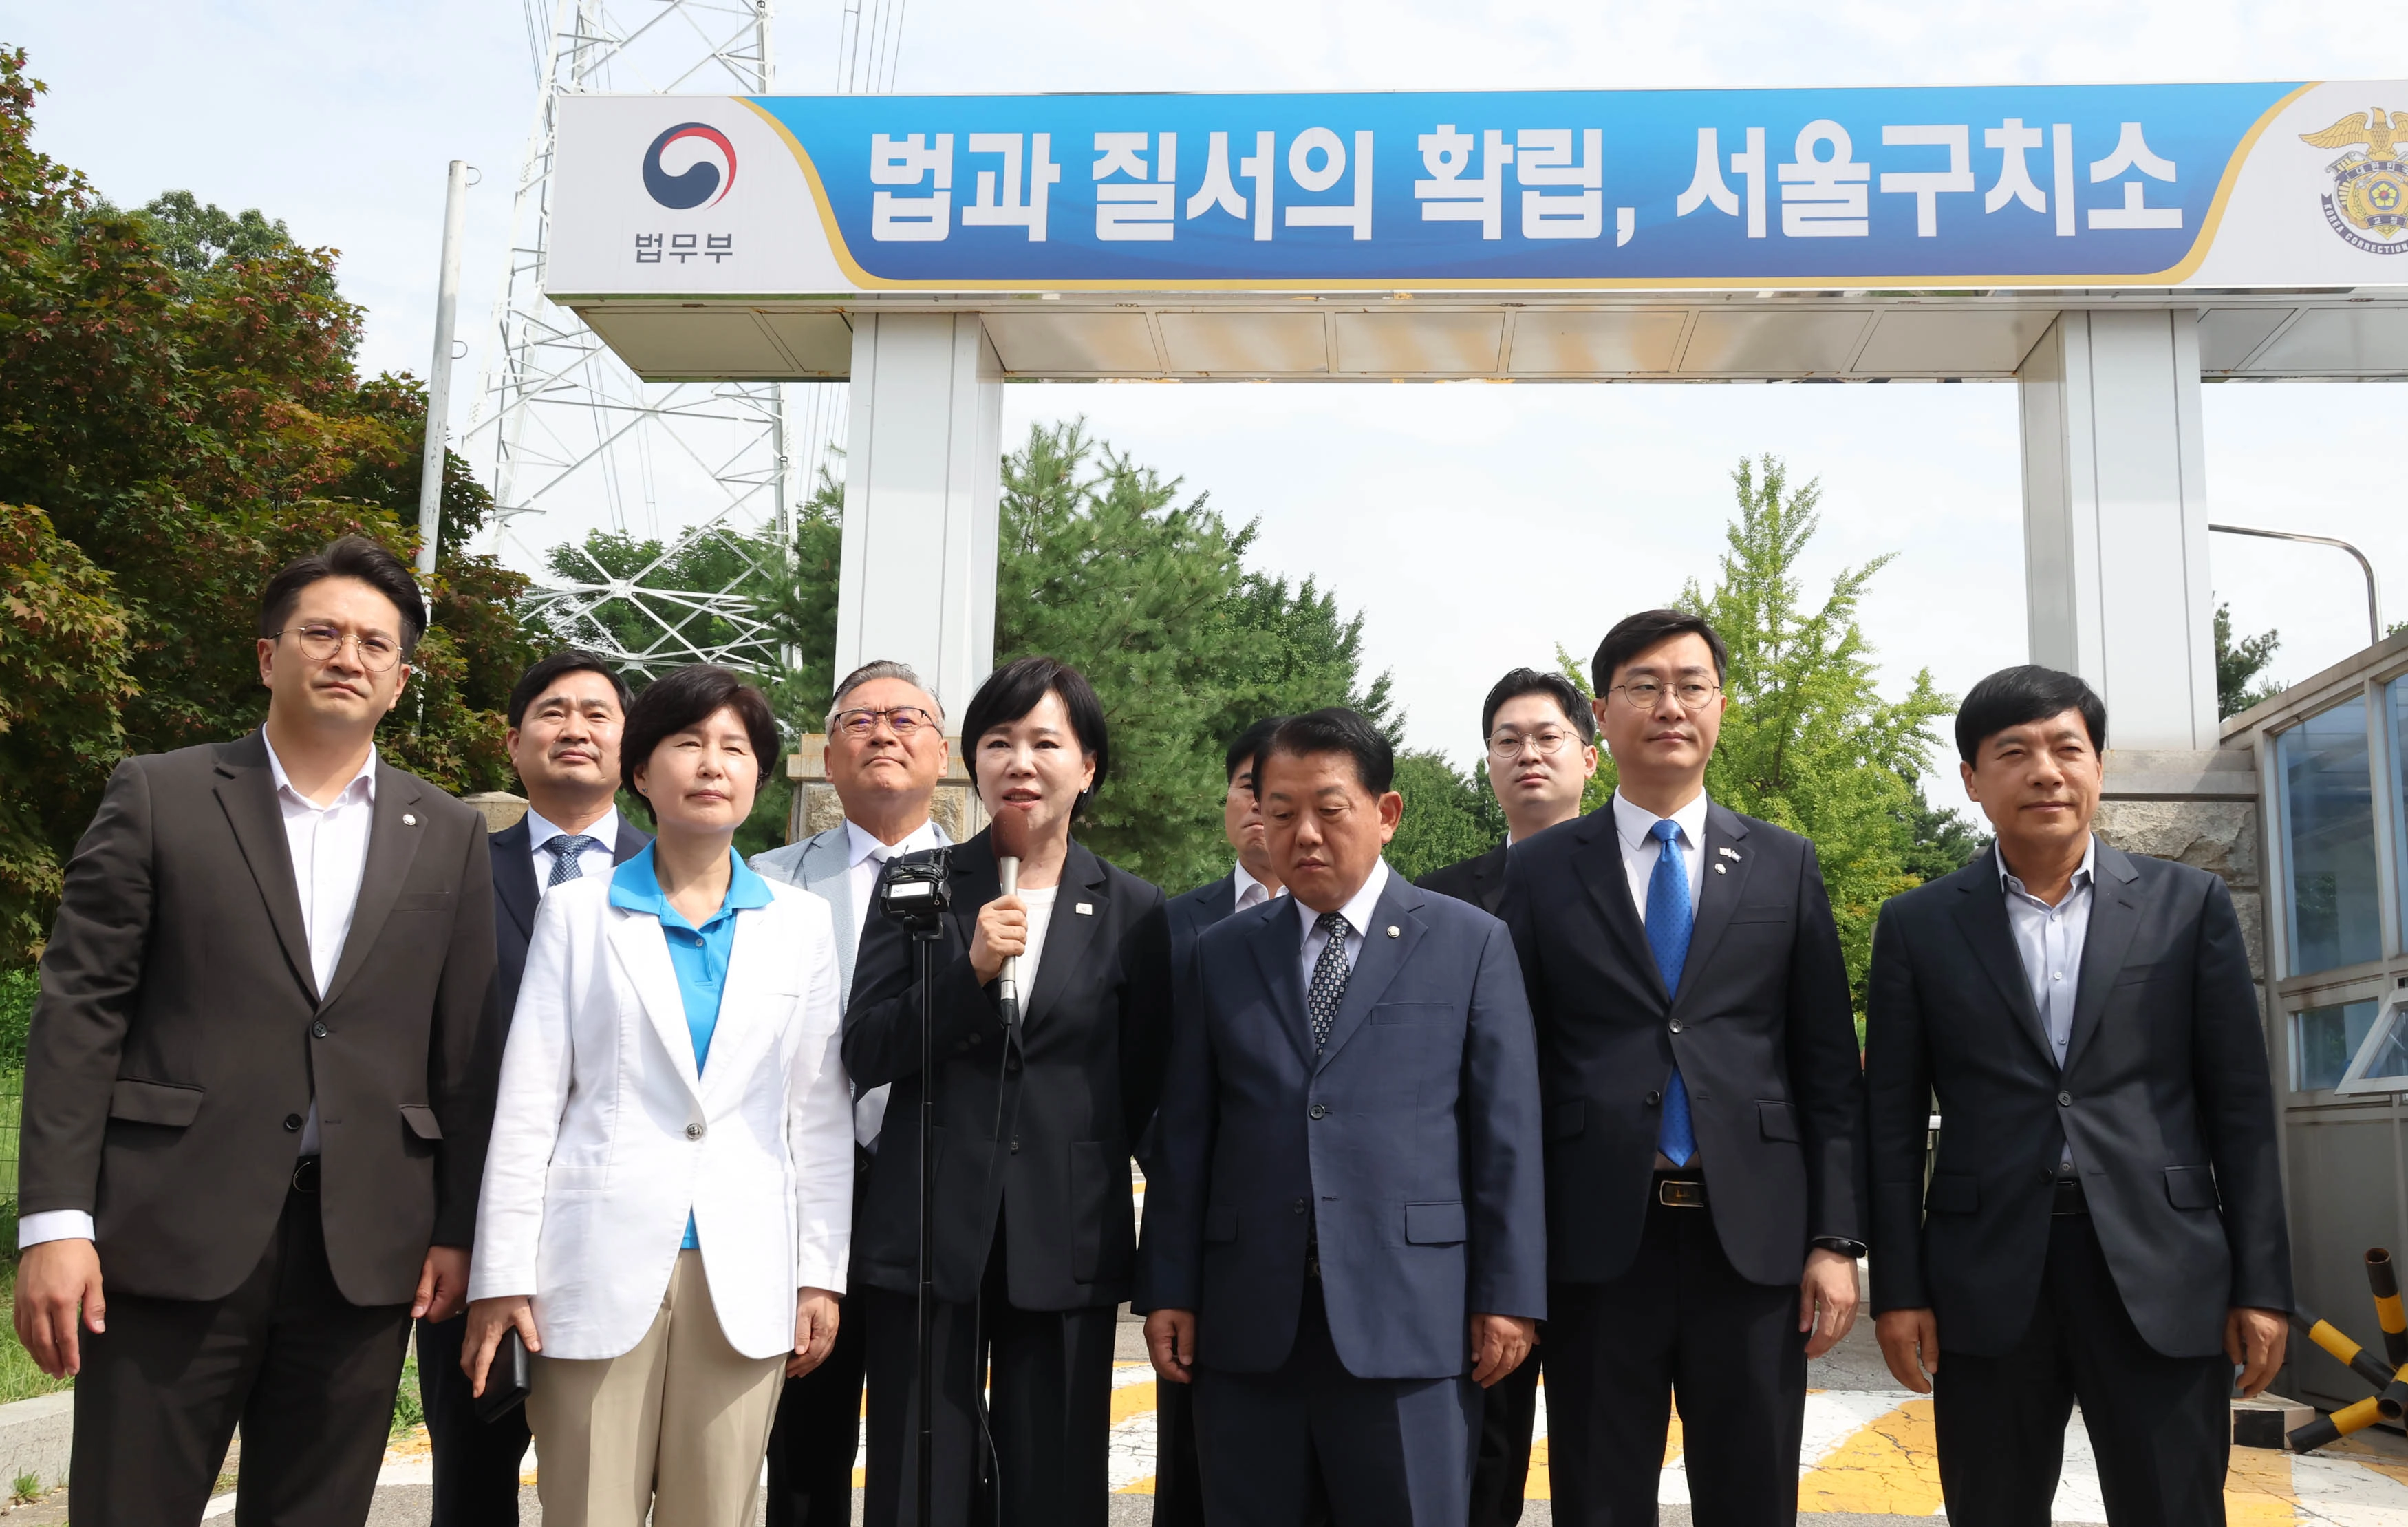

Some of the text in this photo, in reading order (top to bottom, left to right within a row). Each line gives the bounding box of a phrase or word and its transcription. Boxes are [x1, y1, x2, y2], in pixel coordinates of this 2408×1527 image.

[870, 118, 2184, 248] 법과 질서의 확립, 서울구치소
[2323, 203, 2345, 233] KOREA
[2372, 215, 2398, 225] 교정
[635, 233, 733, 264] 법무부
